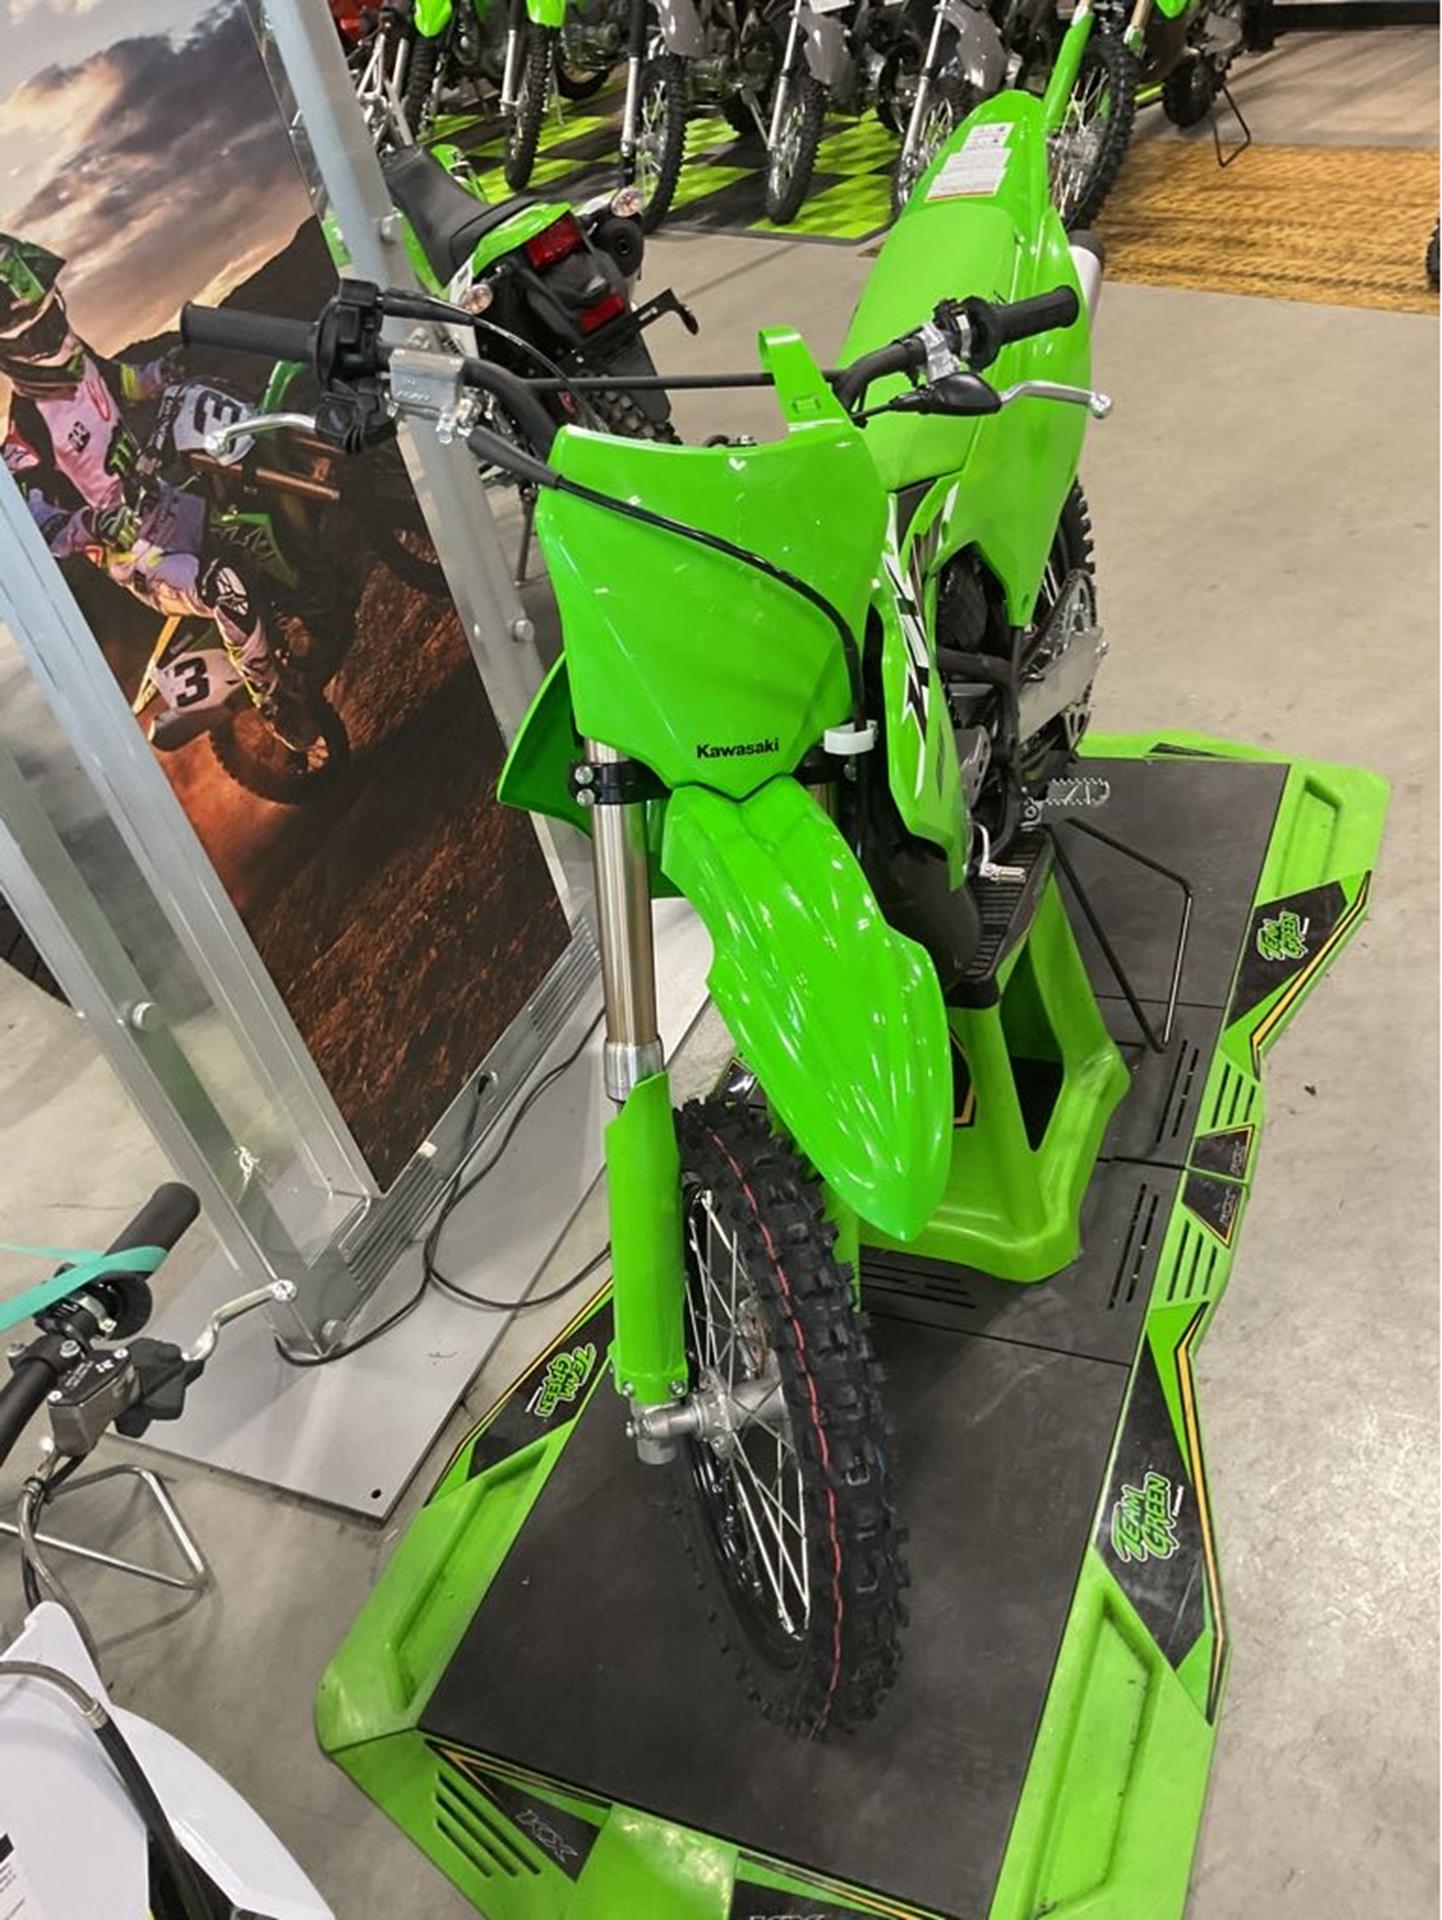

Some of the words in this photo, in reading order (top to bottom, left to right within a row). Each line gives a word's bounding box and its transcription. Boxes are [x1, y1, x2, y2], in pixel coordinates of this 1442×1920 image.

[174, 657, 210, 708] 3
[696, 737, 780, 759] Kawasaki
[534, 1353, 576, 1417] GREEN
[559, 1343, 597, 1401] TEAM
[1112, 1484, 1149, 1562] TEAM
[1142, 1472, 1180, 1559] GREEN
